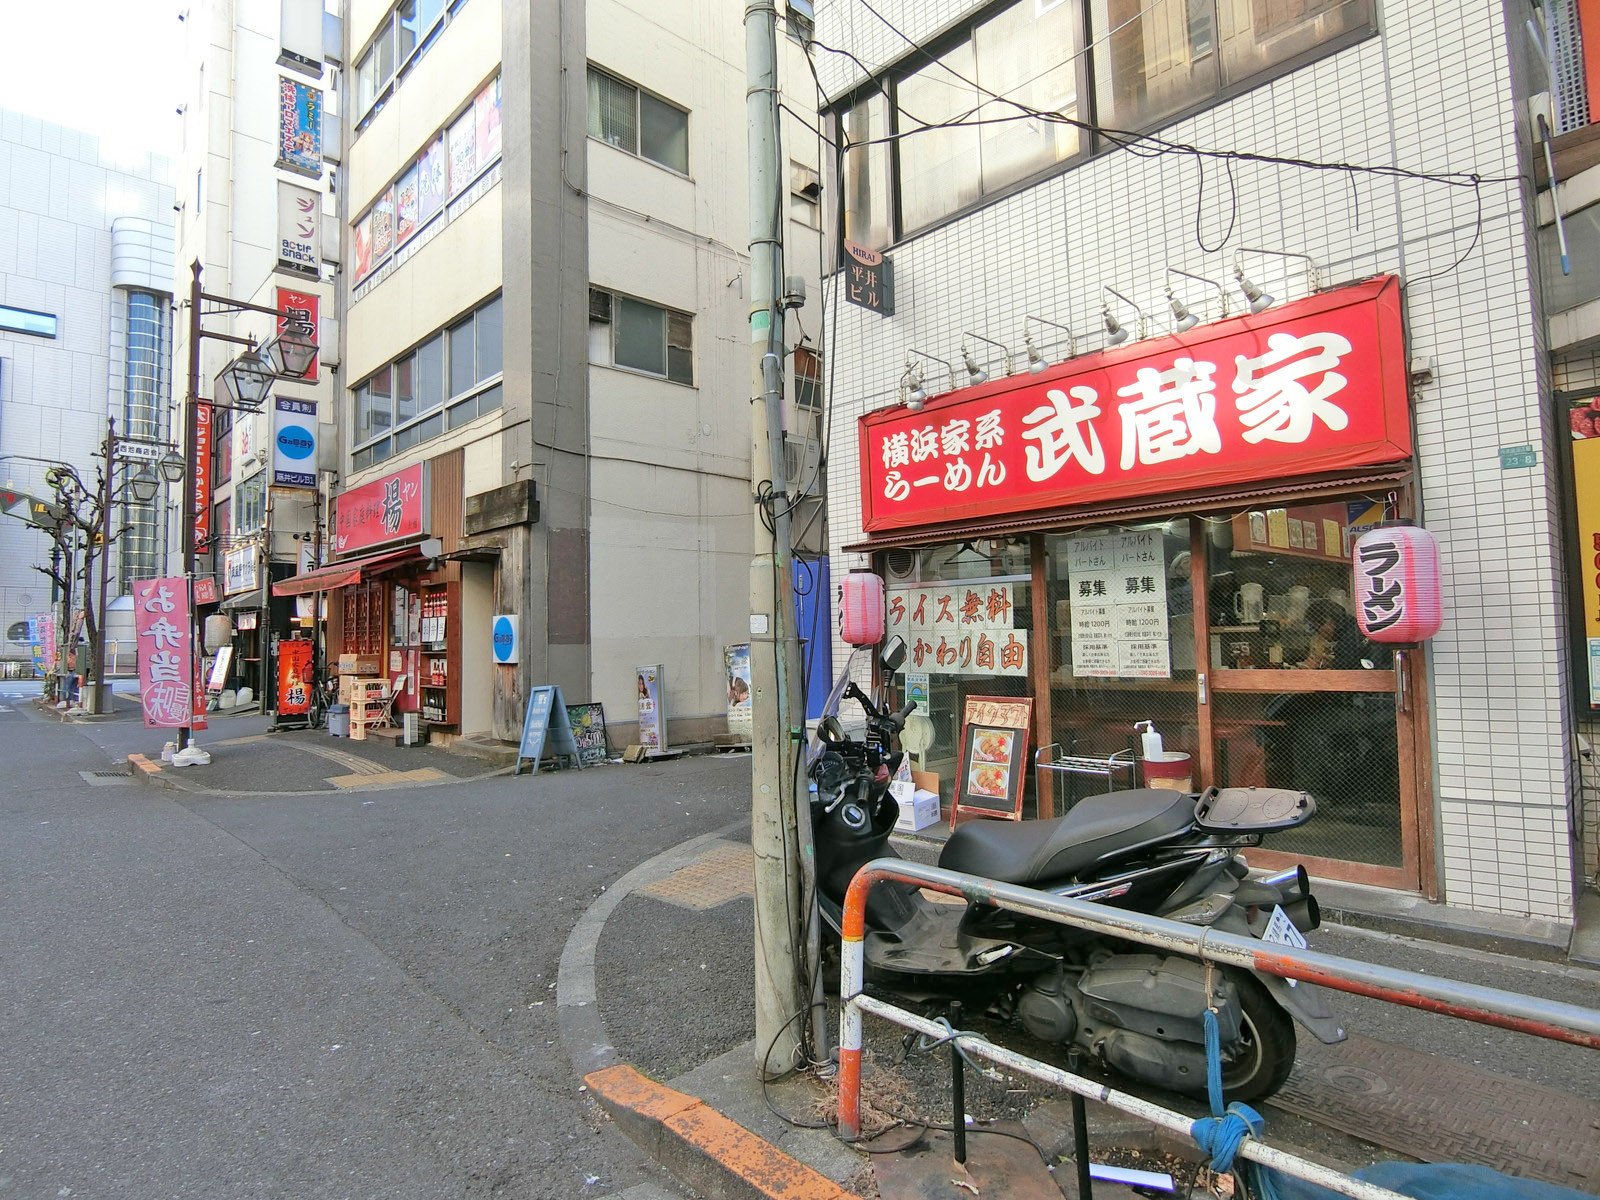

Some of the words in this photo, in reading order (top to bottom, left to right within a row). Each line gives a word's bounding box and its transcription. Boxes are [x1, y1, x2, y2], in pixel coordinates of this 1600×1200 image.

[306, 102, 315, 130] ラミー
[282, 247, 315, 263] snack
[852, 246, 875, 263] HIRAI
[851, 265, 877, 288] 平井
[289, 294, 307, 304] ヤン
[851, 284, 880, 307] ビル
[280, 400, 312, 413] 会員制
[1021, 331, 1353, 484] 武蔵家
[882, 408, 1004, 470] 横浜家系
[120, 444, 157, 457] 西池商店会
[883, 453, 1007, 502] らーめん
[403, 481, 419, 501] ヤン
[1349, 524, 1374, 533] ALS
[1074, 539, 1104, 553] アルバイト
[1120, 535, 1153, 548] アルバイト
[1075, 556, 1106, 567] パートさん
[1121, 551, 1155, 563] パートさん
[1078, 579, 1107, 598] 募集
[1125, 576, 1156, 595] 募集
[1359, 541, 1402, 634] ラーメン
[889, 587, 1012, 625] ライス無料
[902, 632, 1025, 670] かわり自由
[285, 687, 306, 705] 楊
[967, 702, 1028, 727] テイクアウト
